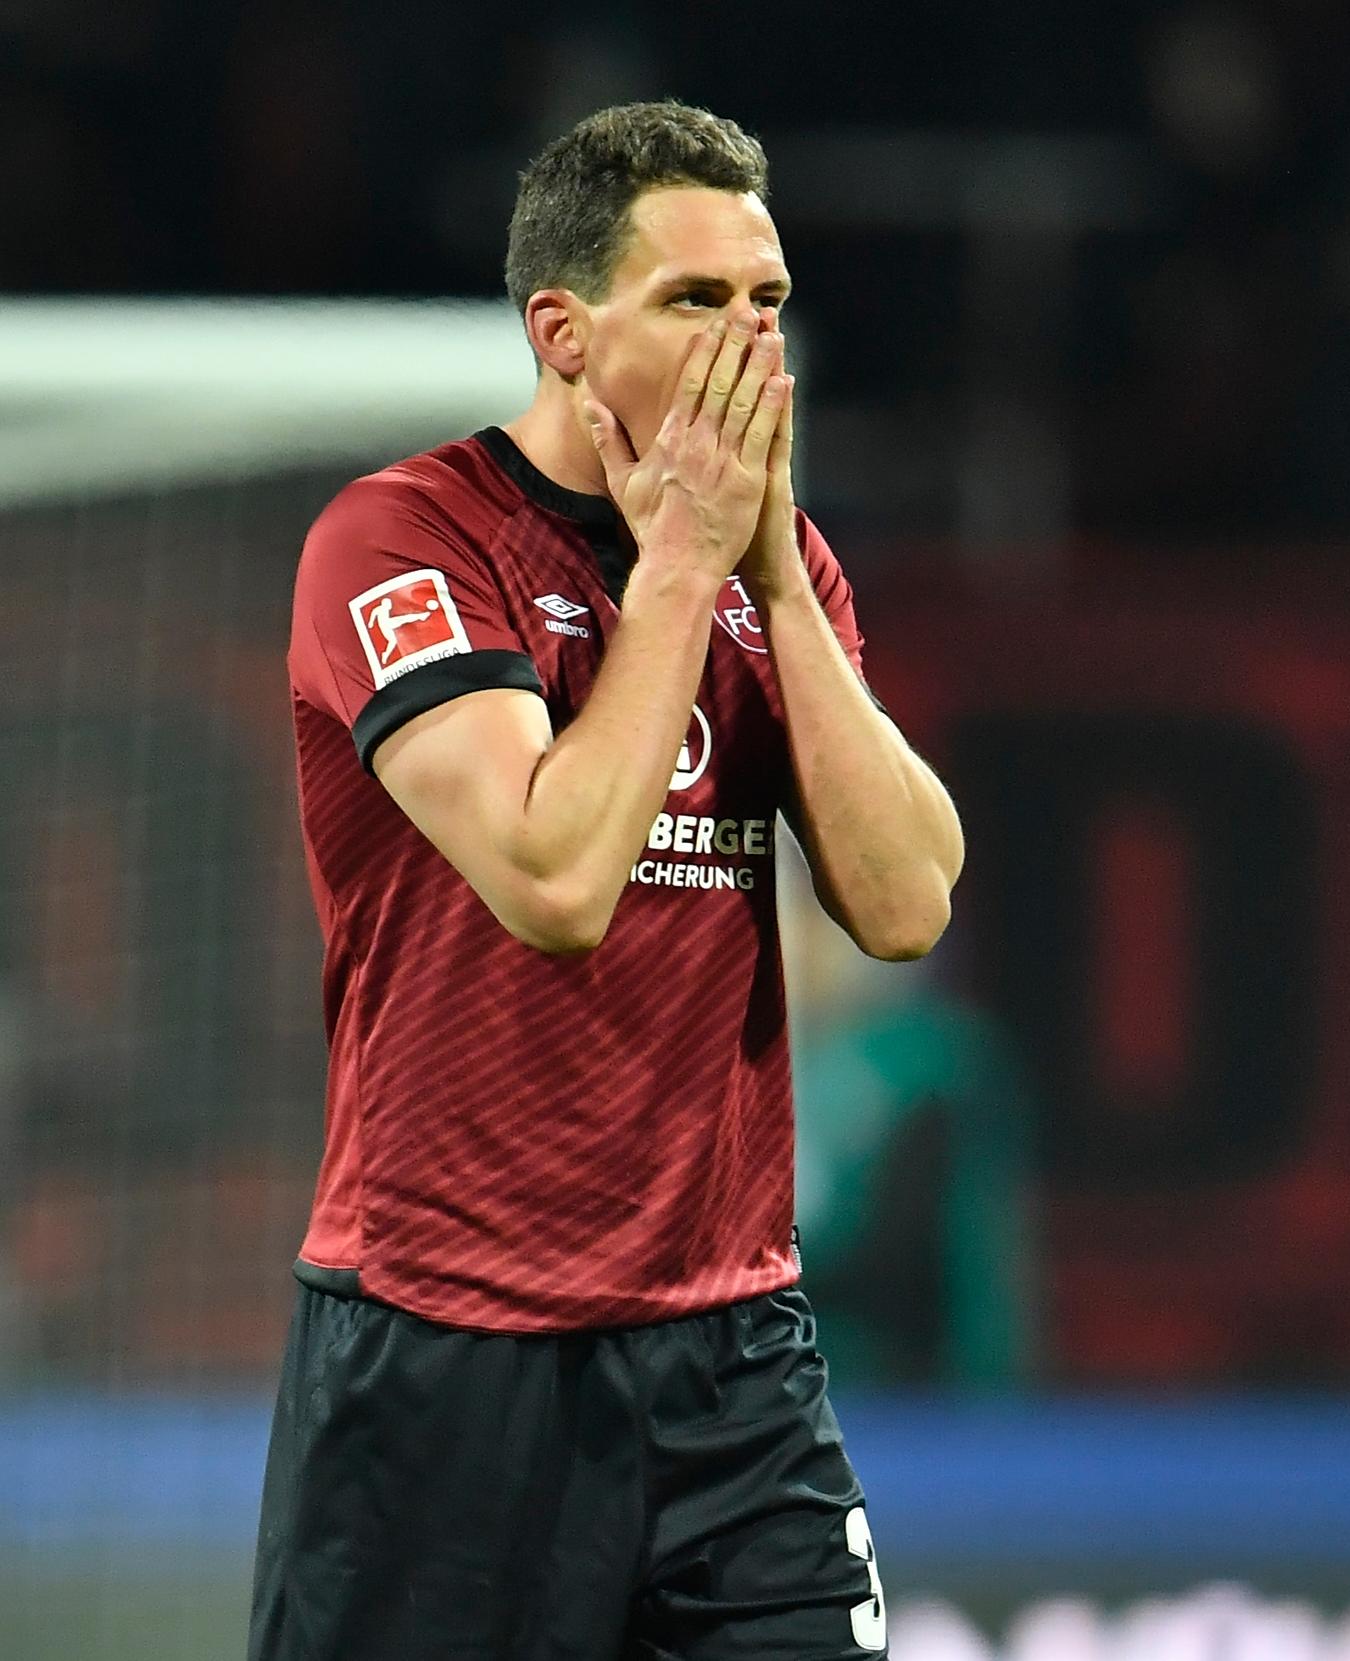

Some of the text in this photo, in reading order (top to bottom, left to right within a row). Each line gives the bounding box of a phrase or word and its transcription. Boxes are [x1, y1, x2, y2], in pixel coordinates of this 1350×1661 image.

[544, 619, 590, 639] umbro
[723, 605, 762, 635] FC
[383, 646, 460, 685] BUNDESLIGA
